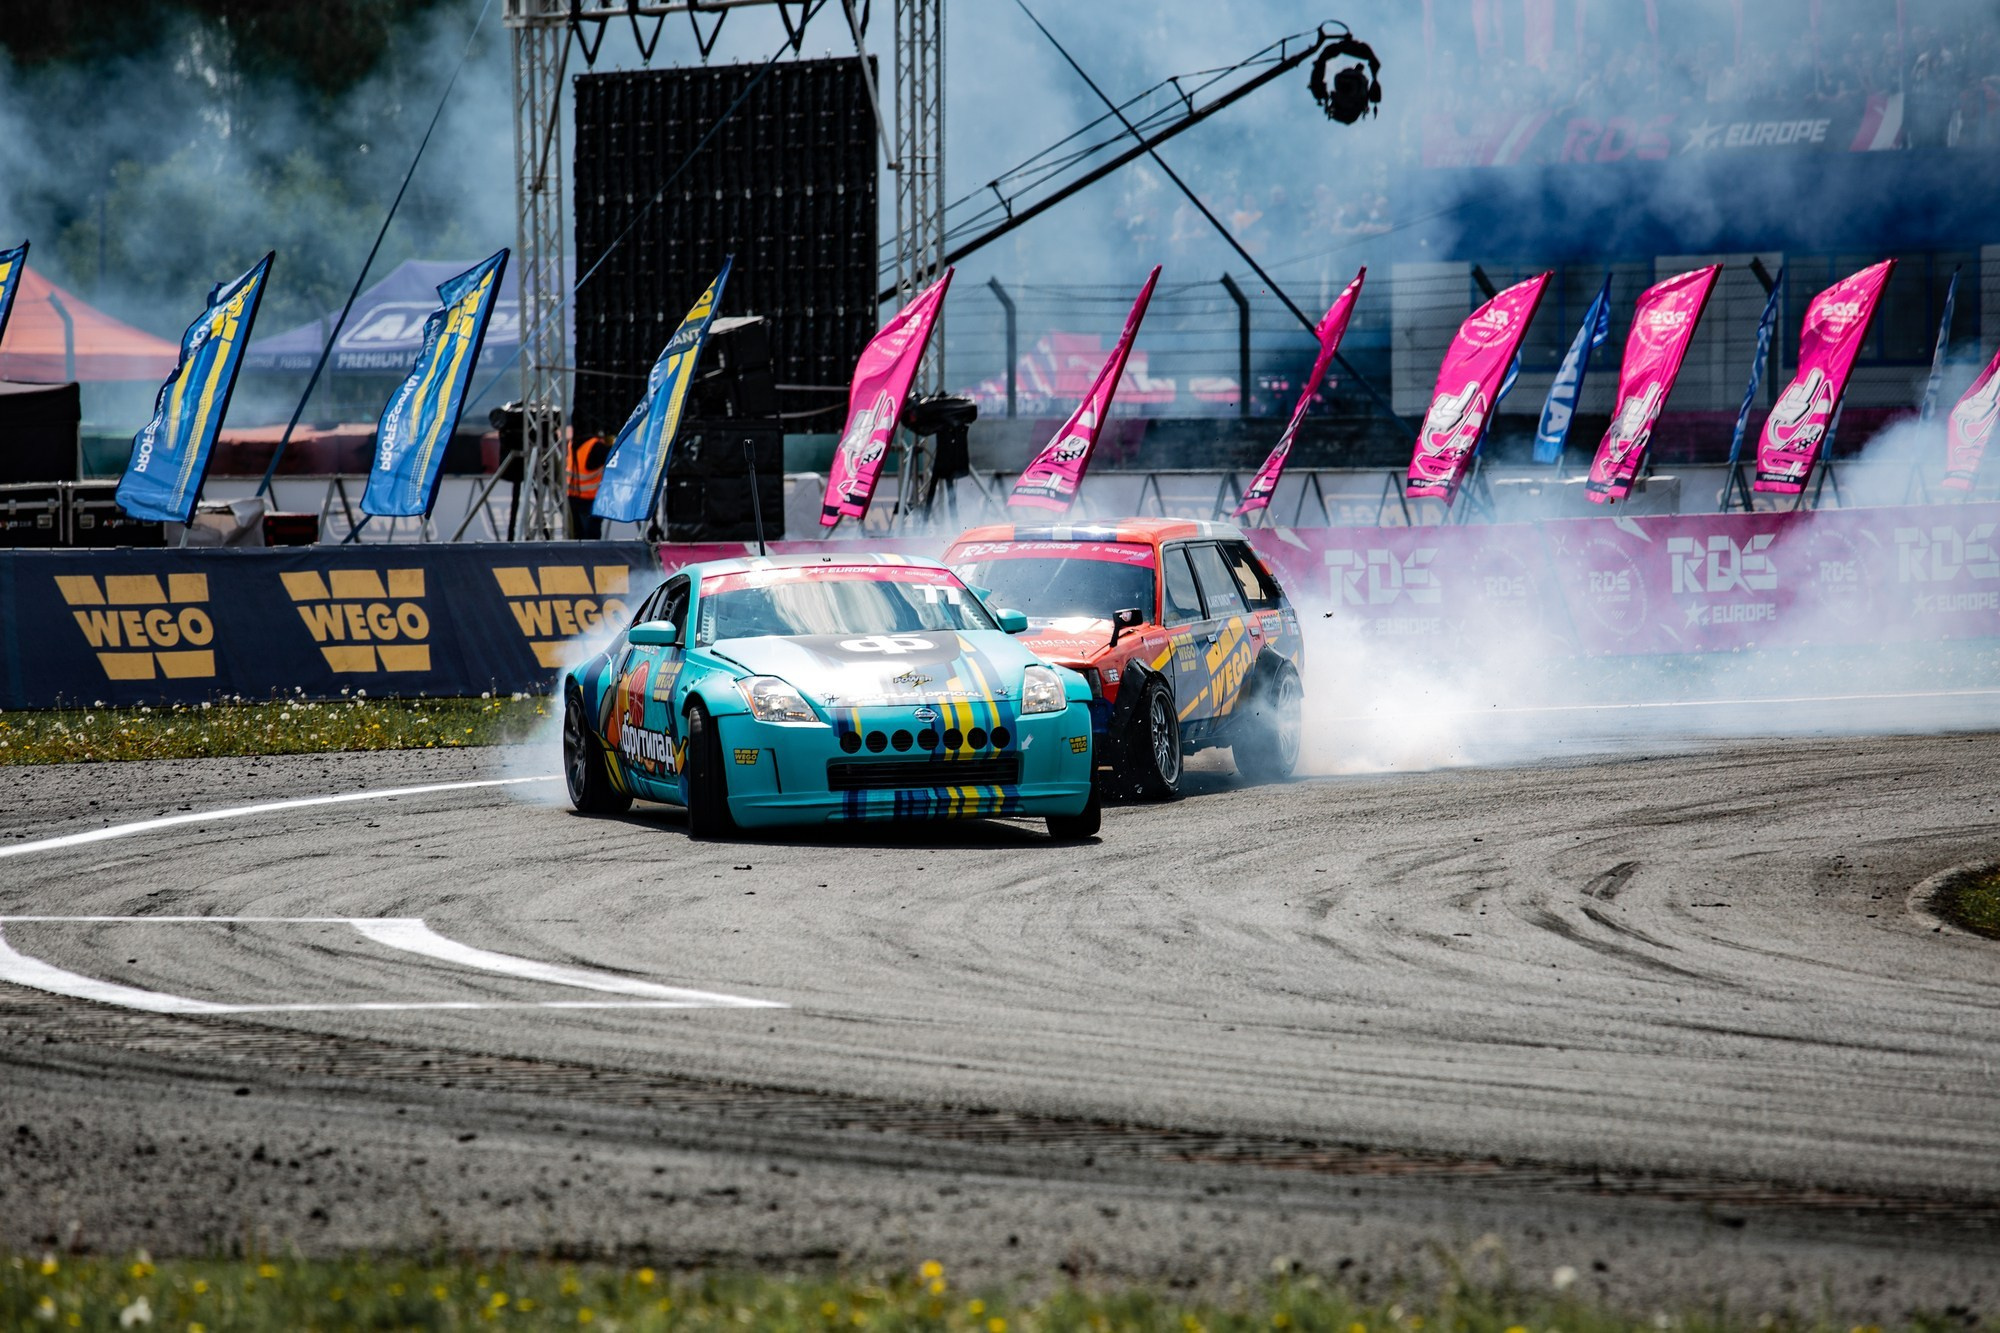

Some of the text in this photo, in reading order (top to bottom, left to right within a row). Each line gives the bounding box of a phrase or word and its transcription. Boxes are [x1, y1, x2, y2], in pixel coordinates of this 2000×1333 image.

[1559, 112, 1831, 164] RDS EUROPE
[338, 353, 404, 369] PREMIUM
[958, 541, 1016, 560] RDS
[1031, 543, 1082, 551] EUROPE
[1894, 523, 2000, 582] RDS
[827, 566, 878, 575] EUROPE
[1667, 534, 1778, 596] RDS
[1819, 560, 1858, 583] RDS
[1324, 549, 1442, 605] RDS
[1484, 576, 1526, 597] RDS
[1588, 570, 1631, 593] RDS
[1936, 591, 1999, 611] EUROPE
[297, 601, 430, 642] WEGO
[508, 598, 631, 638] WEGO
[1712, 603, 1776, 624] EUROPE
[73, 606, 214, 648] WEGO
[1375, 617, 1441, 635] EUROPE
[1178, 645, 1196, 660] WEGO
[656, 673, 675, 690] WEGO
[893, 676, 932, 684] POWER
[1211, 642, 1252, 706] WEGO
[1071, 741, 1088, 750] WEGO
[735, 753, 757, 761] WEGO
